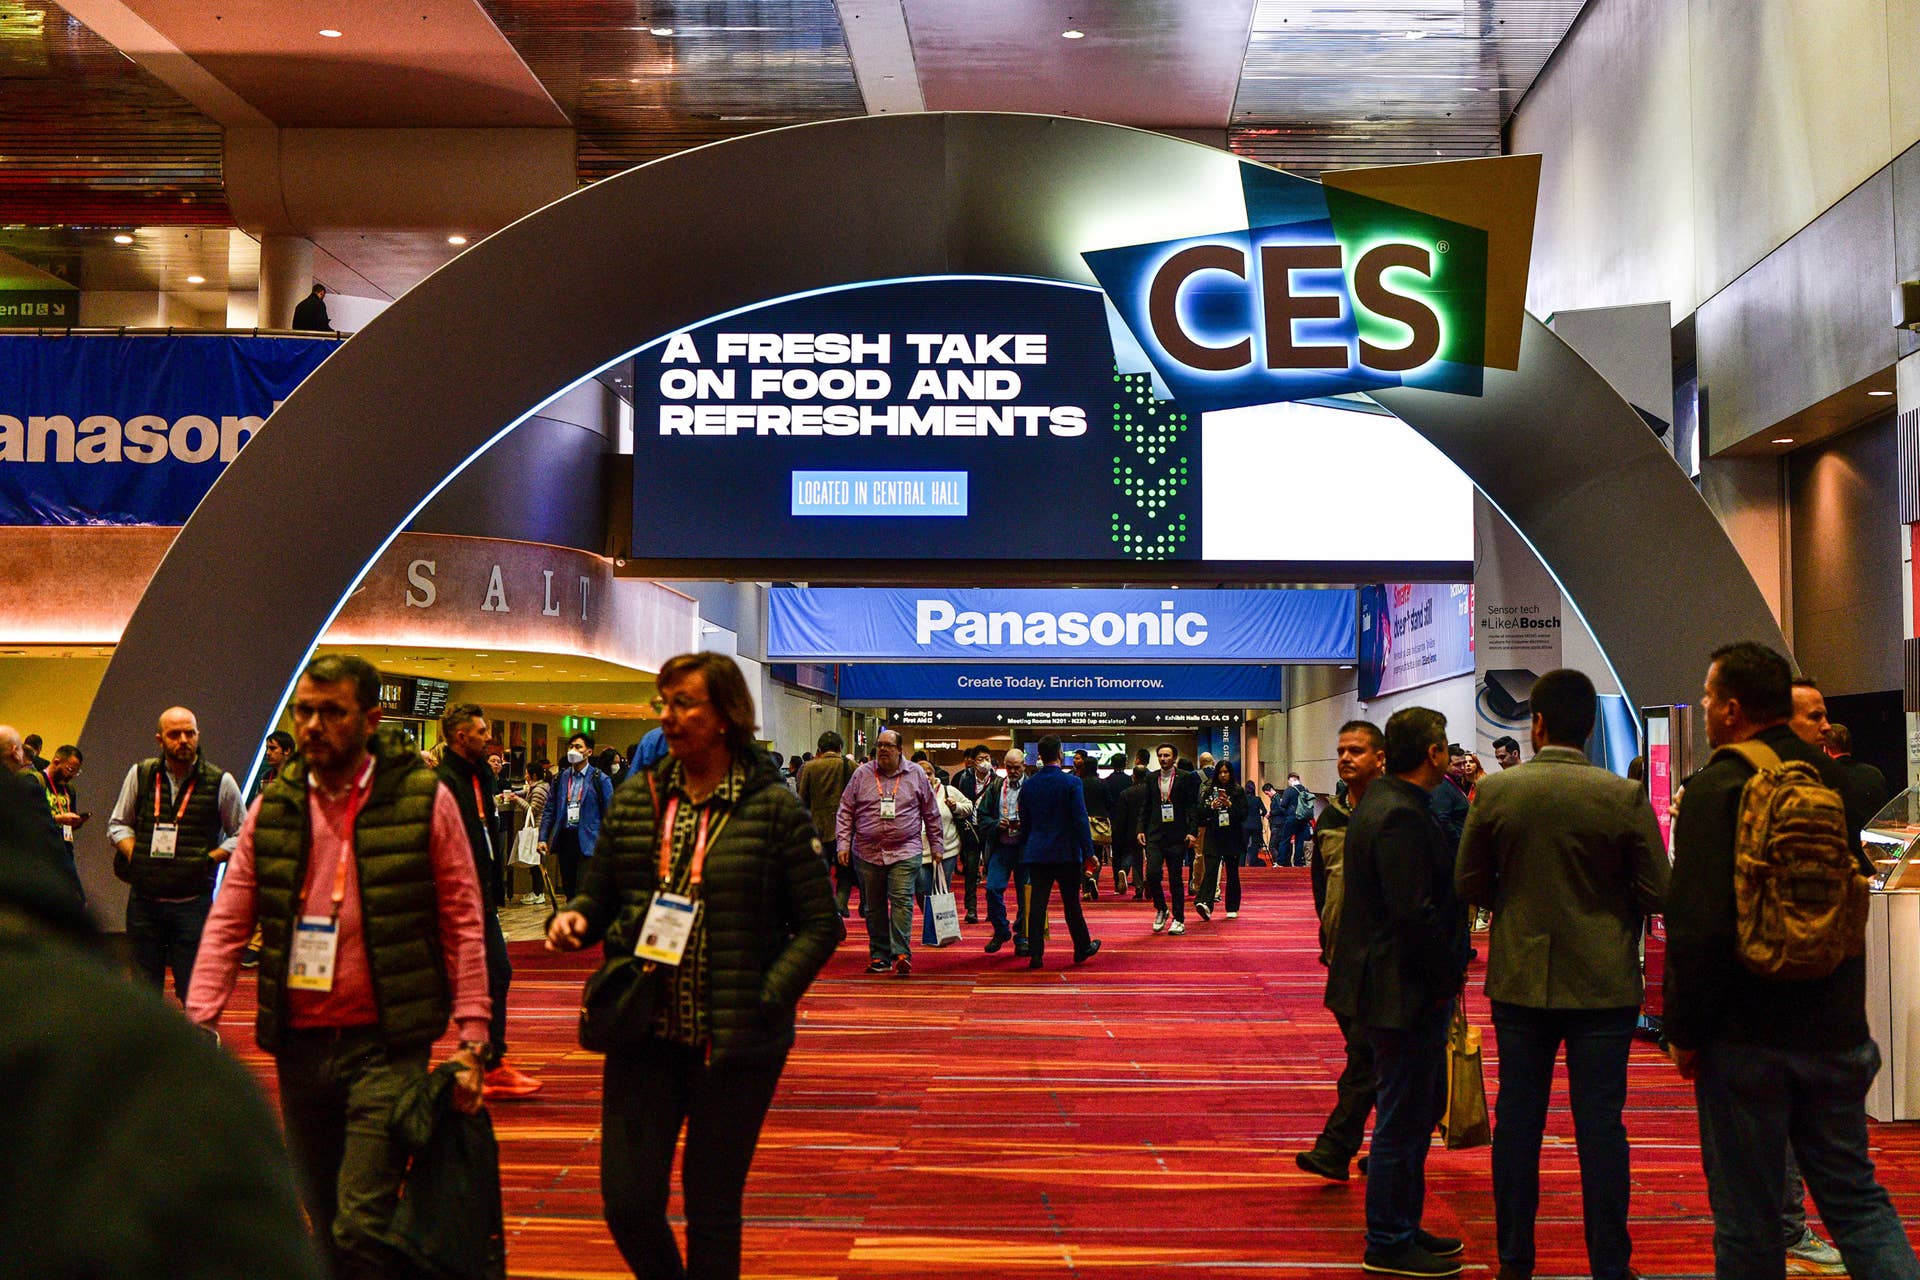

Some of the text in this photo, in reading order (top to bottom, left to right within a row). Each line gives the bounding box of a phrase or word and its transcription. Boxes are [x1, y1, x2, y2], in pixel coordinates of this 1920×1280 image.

[1149, 243, 1441, 371] CES
[660, 333, 1047, 365] A FRESH TAKE
[659, 369, 1022, 400] ON FOOD AND
[0, 400, 284, 464] anason
[659, 405, 1088, 437] REFRESHMENTS
[798, 480, 960, 505] LOCATED IN CENTRAL HALL
[406, 559, 591, 621] SALT
[916, 600, 1208, 646] Panasonic
[1481, 616, 1561, 630] #LikeABosch
[1488, 604, 1540, 615] Sensor tech
[957, 676, 1164, 690] Create Today. Enrich Tomorrow.
[1007, 718, 1032, 726] Meeting
[1088, 718, 1098, 726] (up
[1098, 718, 1127, 726] escalator)
[1026, 711, 1051, 719] Meeting
[925, 742, 951, 750] Security
